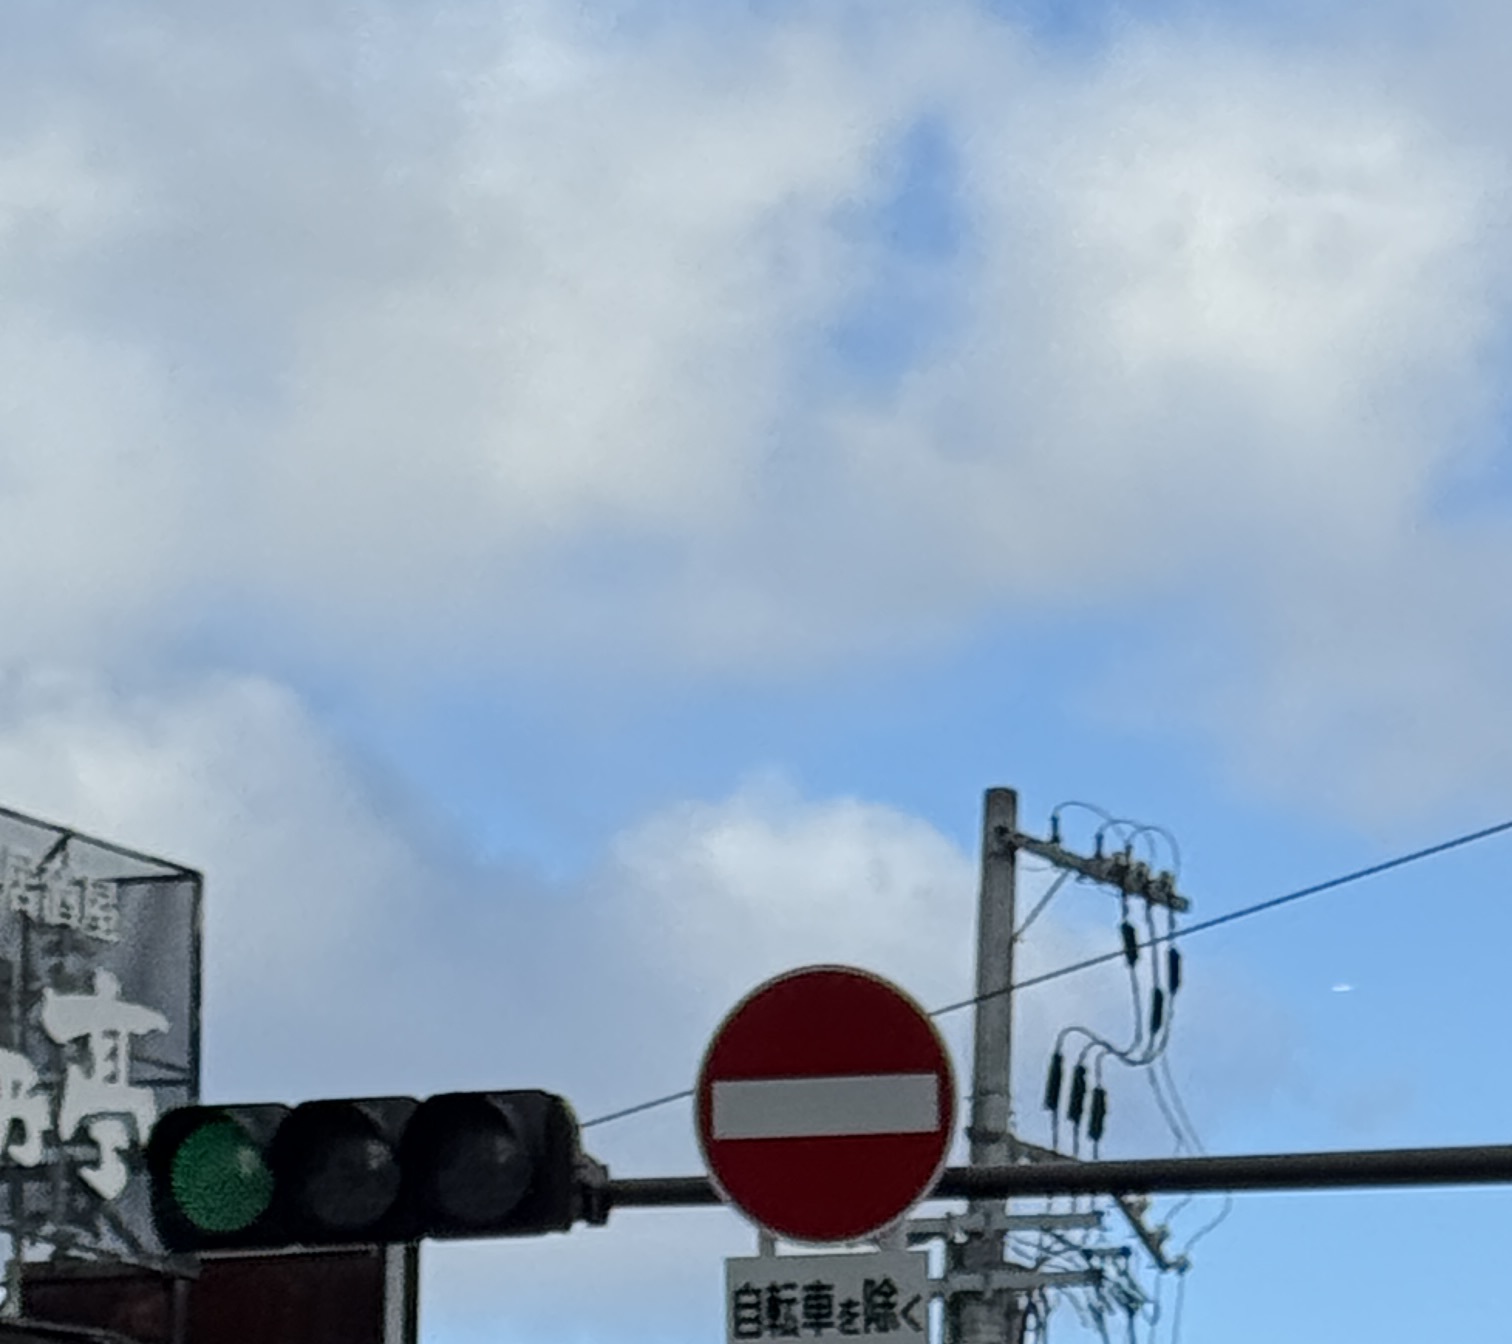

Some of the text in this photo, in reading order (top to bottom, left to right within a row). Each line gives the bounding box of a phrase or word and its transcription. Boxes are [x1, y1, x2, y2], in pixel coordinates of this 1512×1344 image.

[733, 1277, 923, 1340] 自転車を除く
